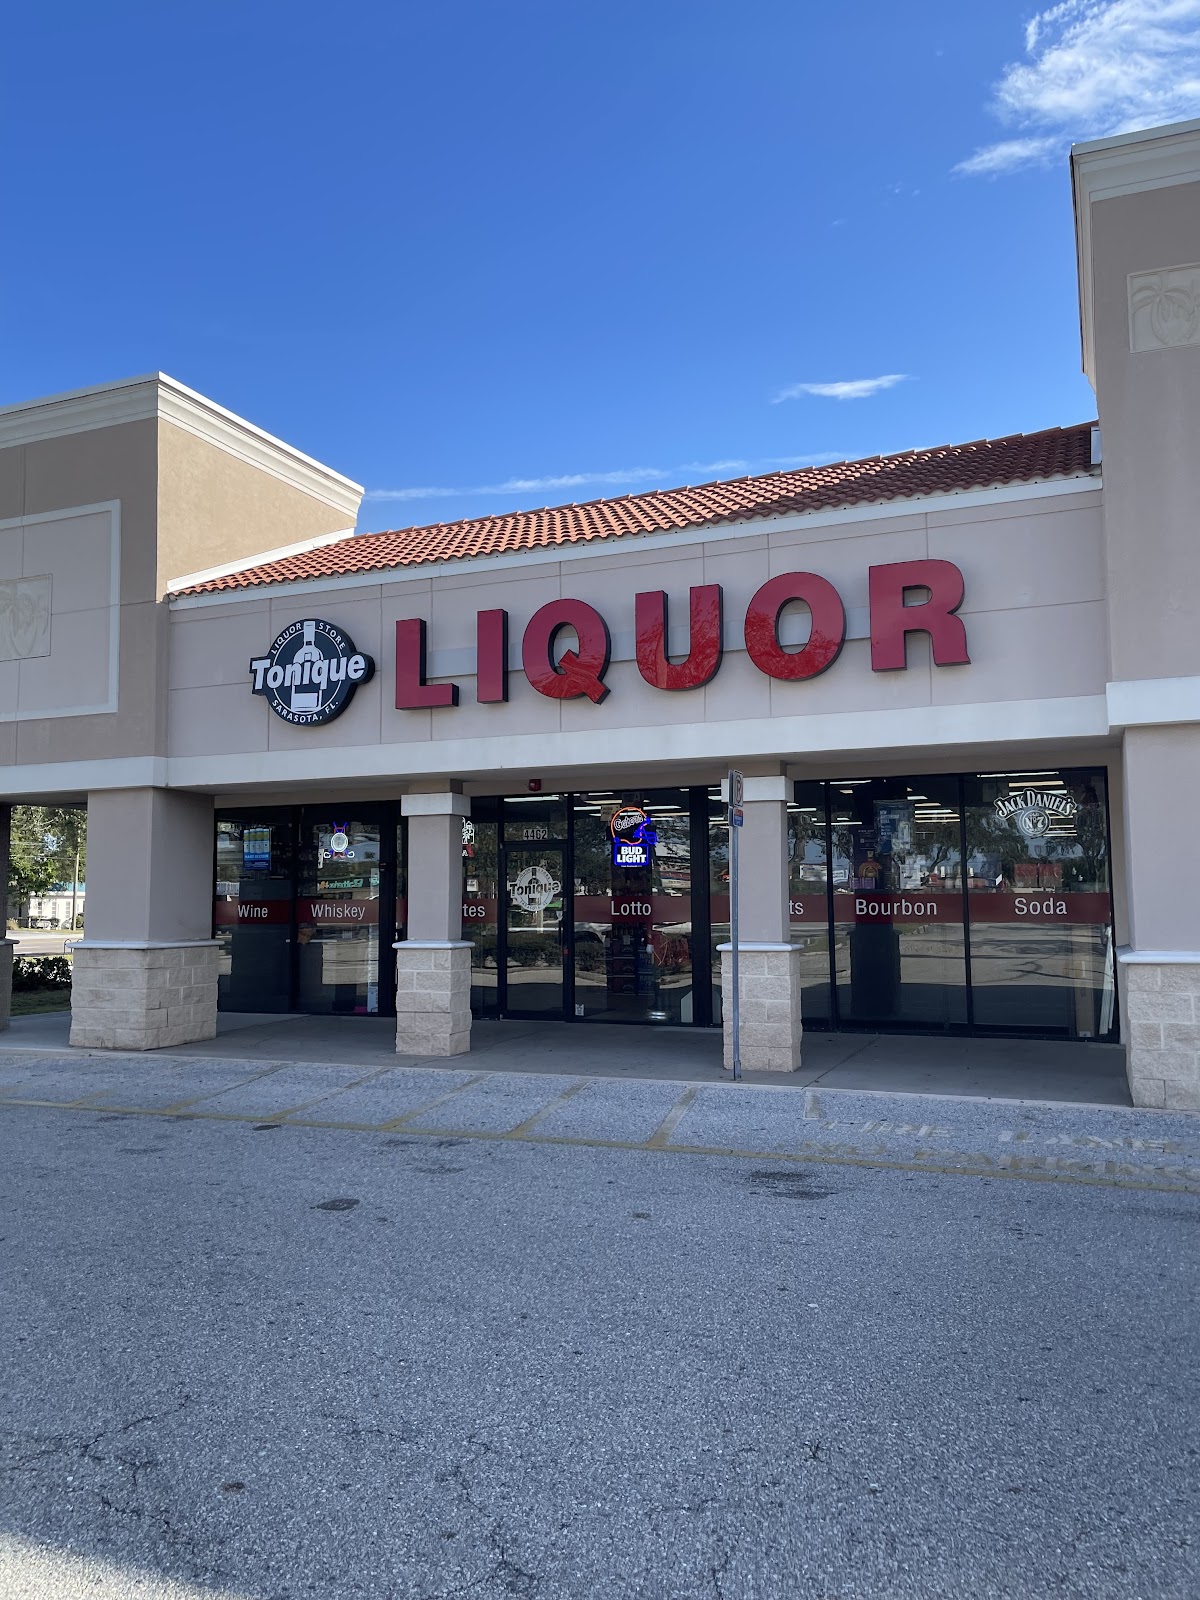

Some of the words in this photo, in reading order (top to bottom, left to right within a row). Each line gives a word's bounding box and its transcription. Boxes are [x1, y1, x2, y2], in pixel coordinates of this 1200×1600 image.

[270, 622, 302, 655] LIQUOR
[318, 622, 346, 650] STORE
[395, 558, 971, 711] LIQUOR
[251, 654, 366, 690] Tonique
[271, 699, 323, 723] SARASOTA,
[325, 701, 339, 714] FL.
[996, 794, 1026, 817] JACK
[1026, 790, 1074, 816] DANIEL'S
[524, 829, 547, 840] 4462
[617, 855, 647, 863] LIGHT
[621, 846, 643, 855] BUD
[509, 881, 560, 897] Tonique
[237, 904, 268, 918] Wine
[311, 904, 365, 920] Whiskey
[610, 900, 652, 916] Lotto
[855, 898, 937, 916] Bourbon
[1014, 897, 1067, 915] Soda
